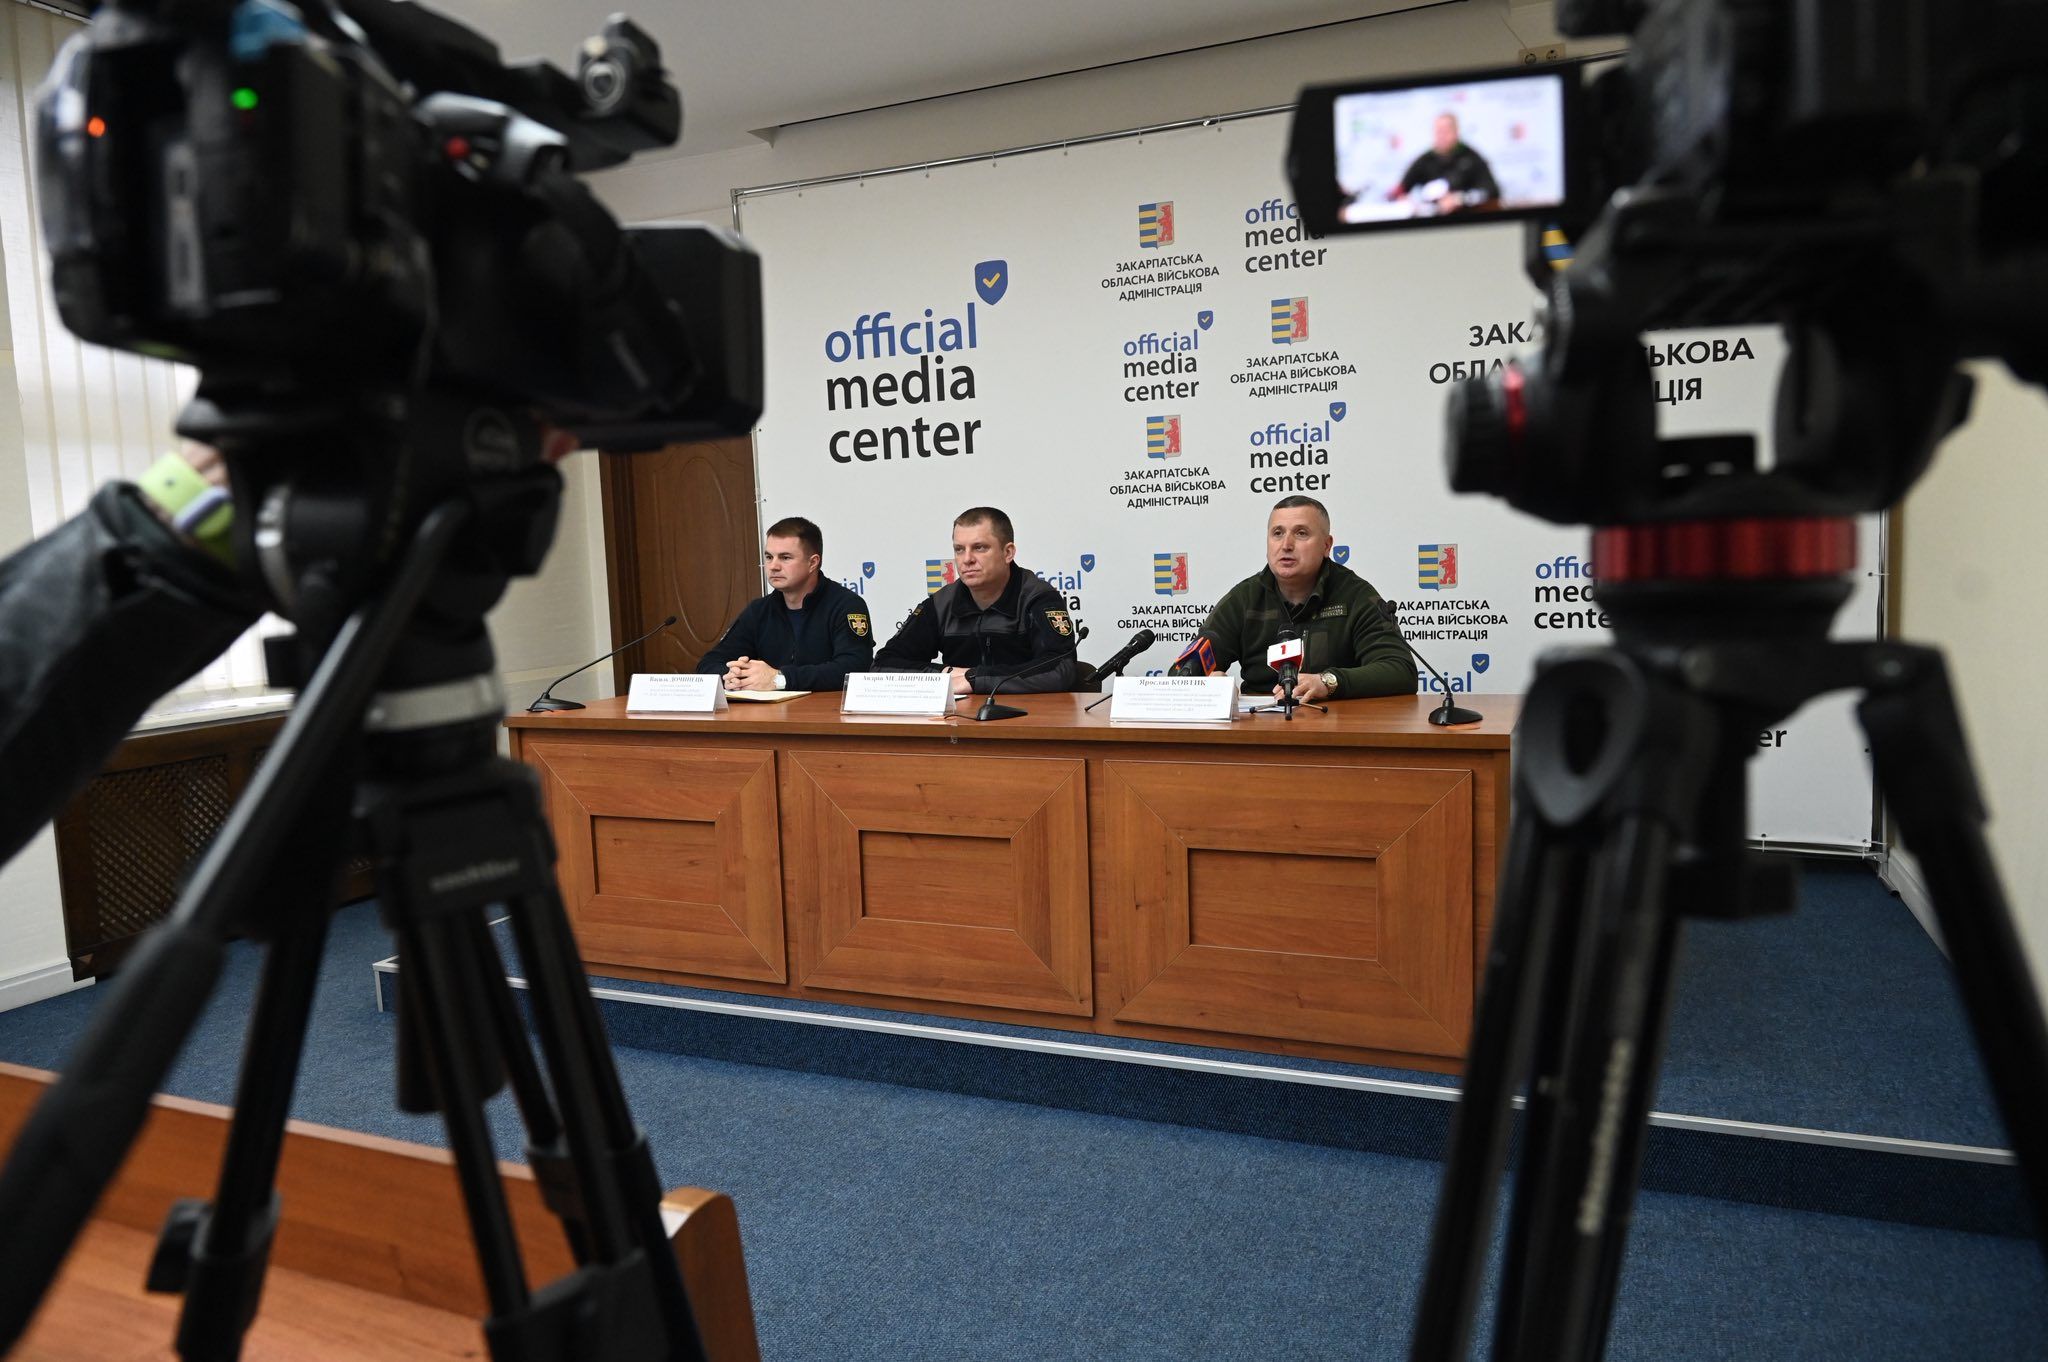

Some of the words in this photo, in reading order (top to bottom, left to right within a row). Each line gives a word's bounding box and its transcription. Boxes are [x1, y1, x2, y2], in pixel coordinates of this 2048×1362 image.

[1245, 198, 1299, 224] offic
[1116, 253, 1204, 272] ЗАКАРПАТСЬКА
[1245, 248, 1327, 273] center
[1101, 273, 1155, 288] ОБЛАСНА
[1157, 266, 1220, 283] ВІЙСЬКОВА
[1119, 282, 1202, 302] АДМІНІСТРАЦІЯ
[825, 302, 977, 363] official
[1123, 329, 1198, 356] official
[1246, 351, 1340, 368] ЗАКАРПАТСЬКА
[1644, 337, 1755, 367] ЬКОВА
[1124, 352, 1197, 378] media
[1230, 370, 1287, 384] ОБЛАСНА
[1290, 364, 1357, 379] ВІЙСЬКОВА
[826, 355, 976, 411] media
[1124, 380, 1200, 402] center
[1249, 380, 1338, 398] АДМІНІСТРАЦІЯ
[829, 417, 982, 464] center
[1250, 420, 1330, 446] official
[1250, 443, 1328, 468] media
[1124, 466, 1210, 480] ЗАКАРПАТСЬКА
[1250, 471, 1331, 493] center
[1109, 483, 1163, 495] ОБЛАСНА
[1165, 480, 1226, 492] ВІЙСЬКОВА
[1127, 495, 1209, 509] АДМІНІСТРАЦІЯ
[1535, 555, 1595, 579] offic
[1396, 600, 1490, 611] АКАРПАТСЬКА
[1117, 619, 1170, 628] ОБЛАСНА
[1172, 617, 1204, 628] ВІЙСЬ
[1397, 615, 1435, 626] АСНА
[1437, 613, 1509, 625] ВІЙСЬКОВА
[1534, 608, 1616, 629] cente
[1403, 629, 1488, 641] ДМІНІСТРАЦІЯ
[1280, 644, 1287, 655] 1
